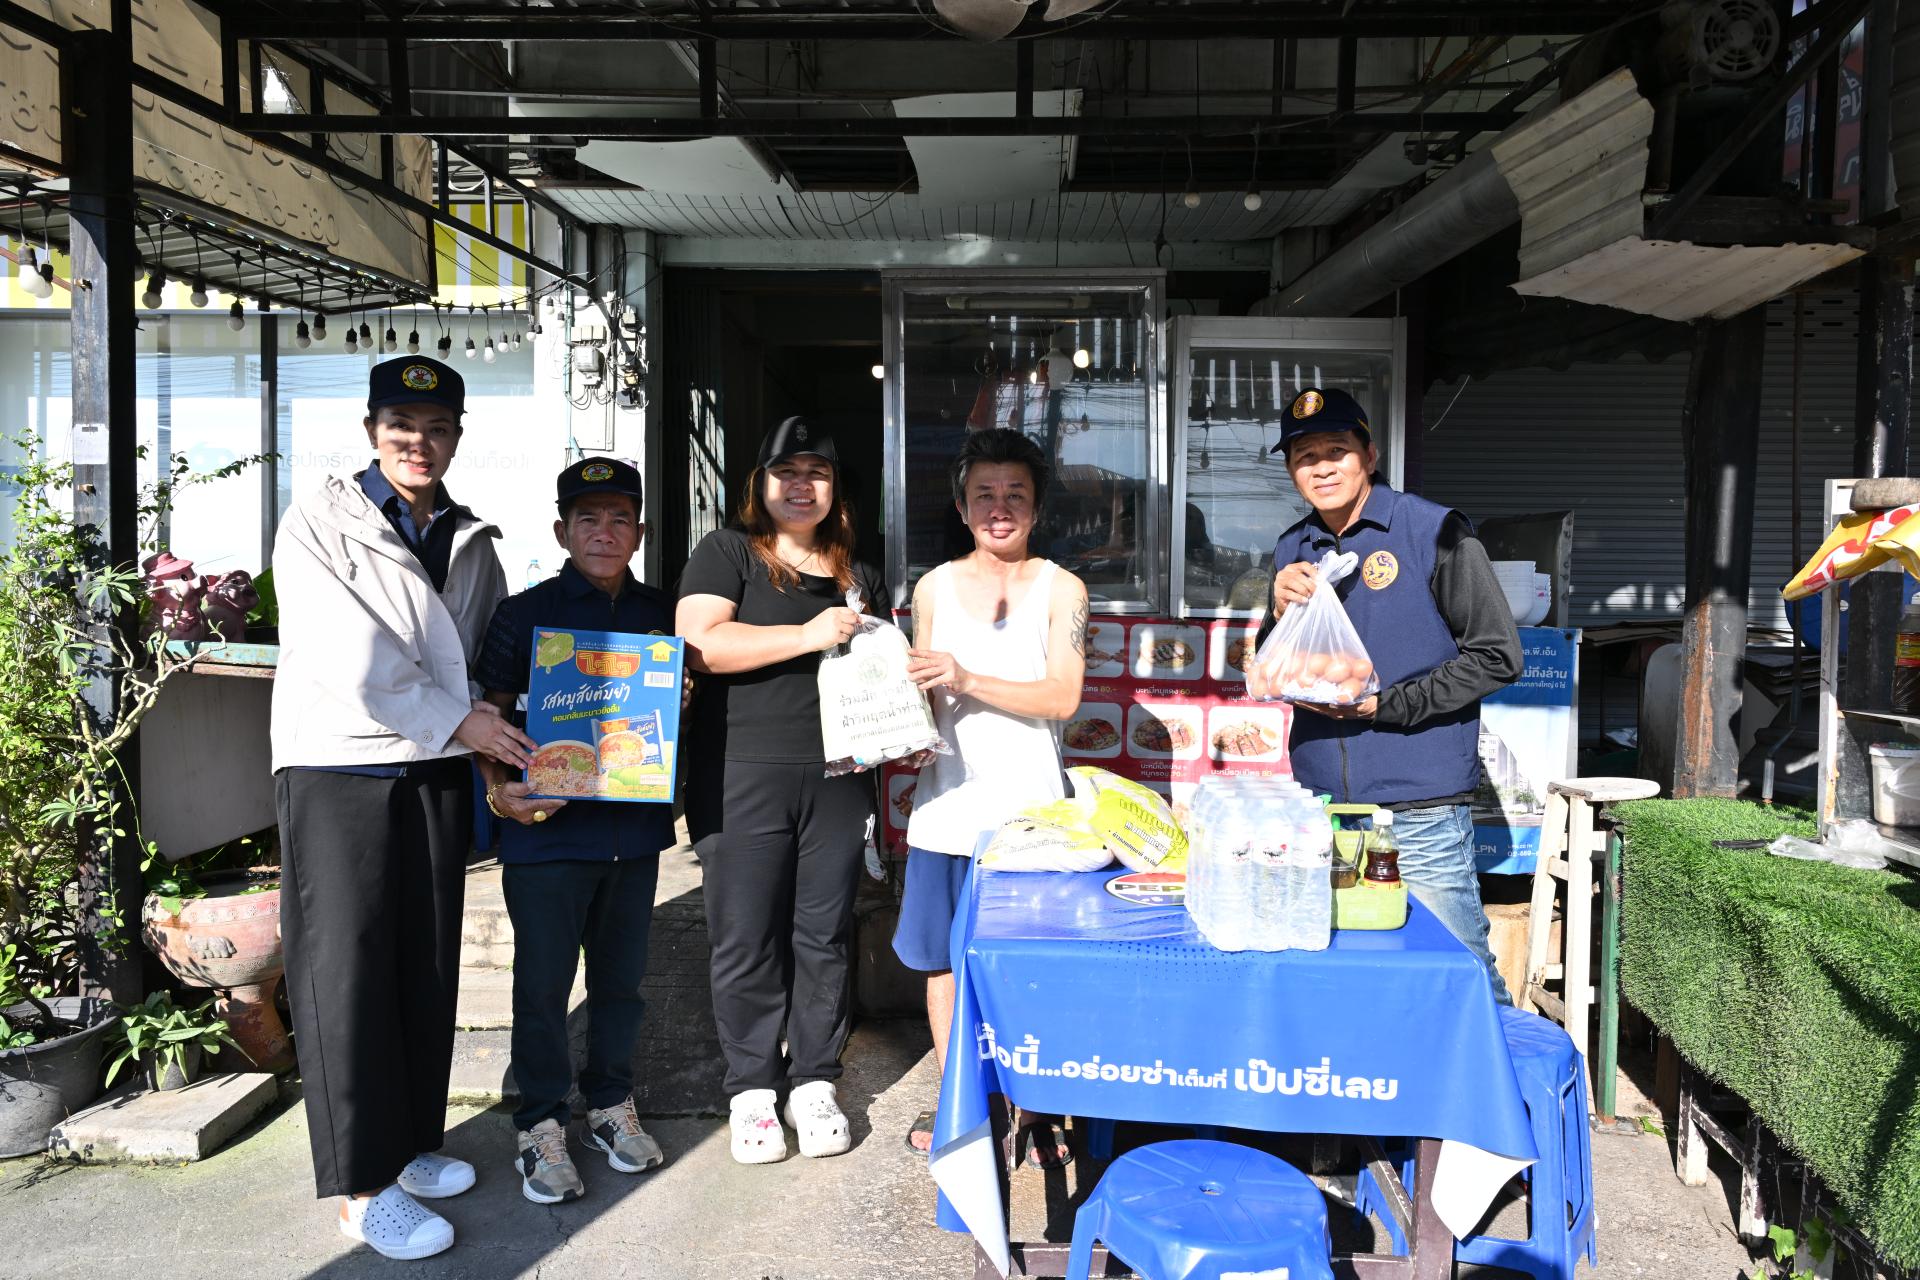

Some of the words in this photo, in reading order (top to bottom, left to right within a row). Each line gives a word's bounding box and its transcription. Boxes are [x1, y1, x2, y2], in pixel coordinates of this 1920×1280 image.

[1521, 646, 1557, 657] ล.พี.เอ็น
[1521, 665, 1568, 679] ม่ถึงล้าน
[541, 681, 631, 711] รสหมูสับต้มยำ
[1114, 883, 1185, 892] PEP
[1234, 1056, 1399, 1101] เป๊ปซี่เลย
